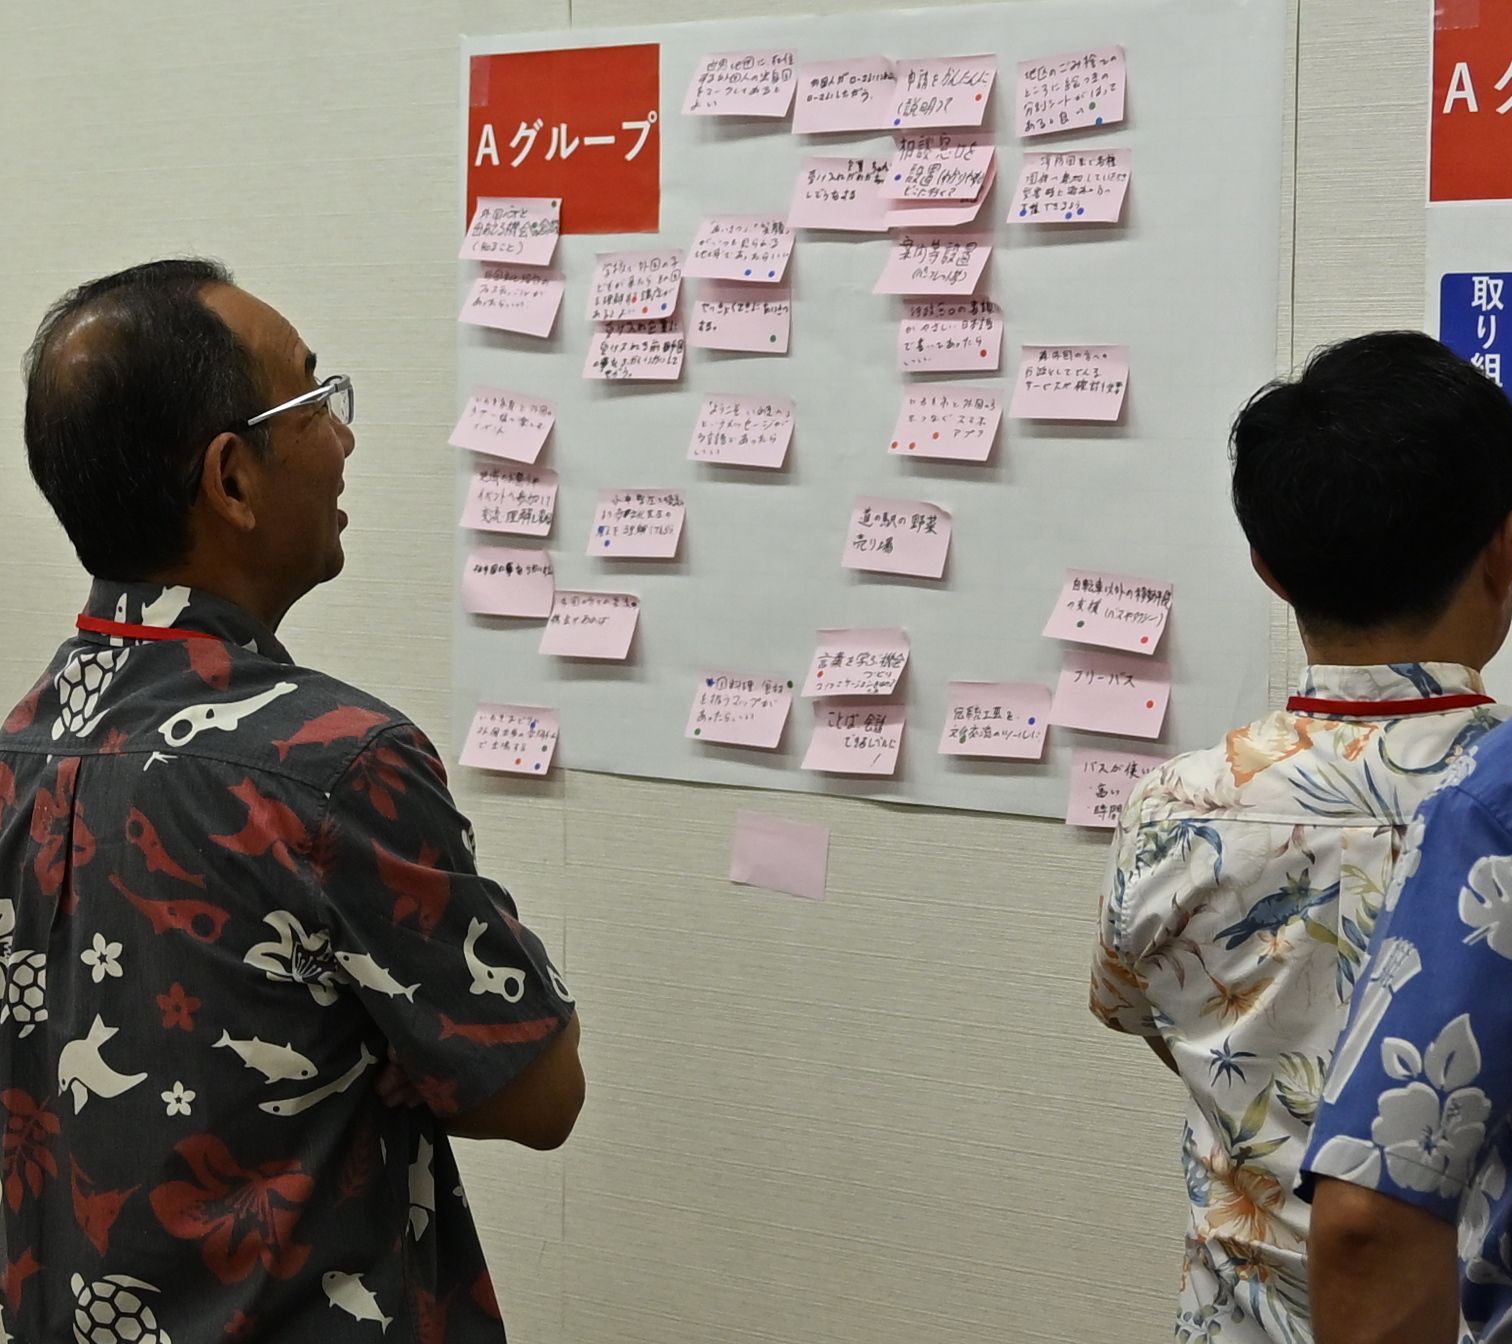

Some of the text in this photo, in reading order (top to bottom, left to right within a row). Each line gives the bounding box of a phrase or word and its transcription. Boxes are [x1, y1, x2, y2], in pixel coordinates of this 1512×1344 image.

[475, 109, 658, 167] Aグループ
[857, 506, 938, 535] 道の駅の野菜
[852, 533, 894, 554] 売り場
